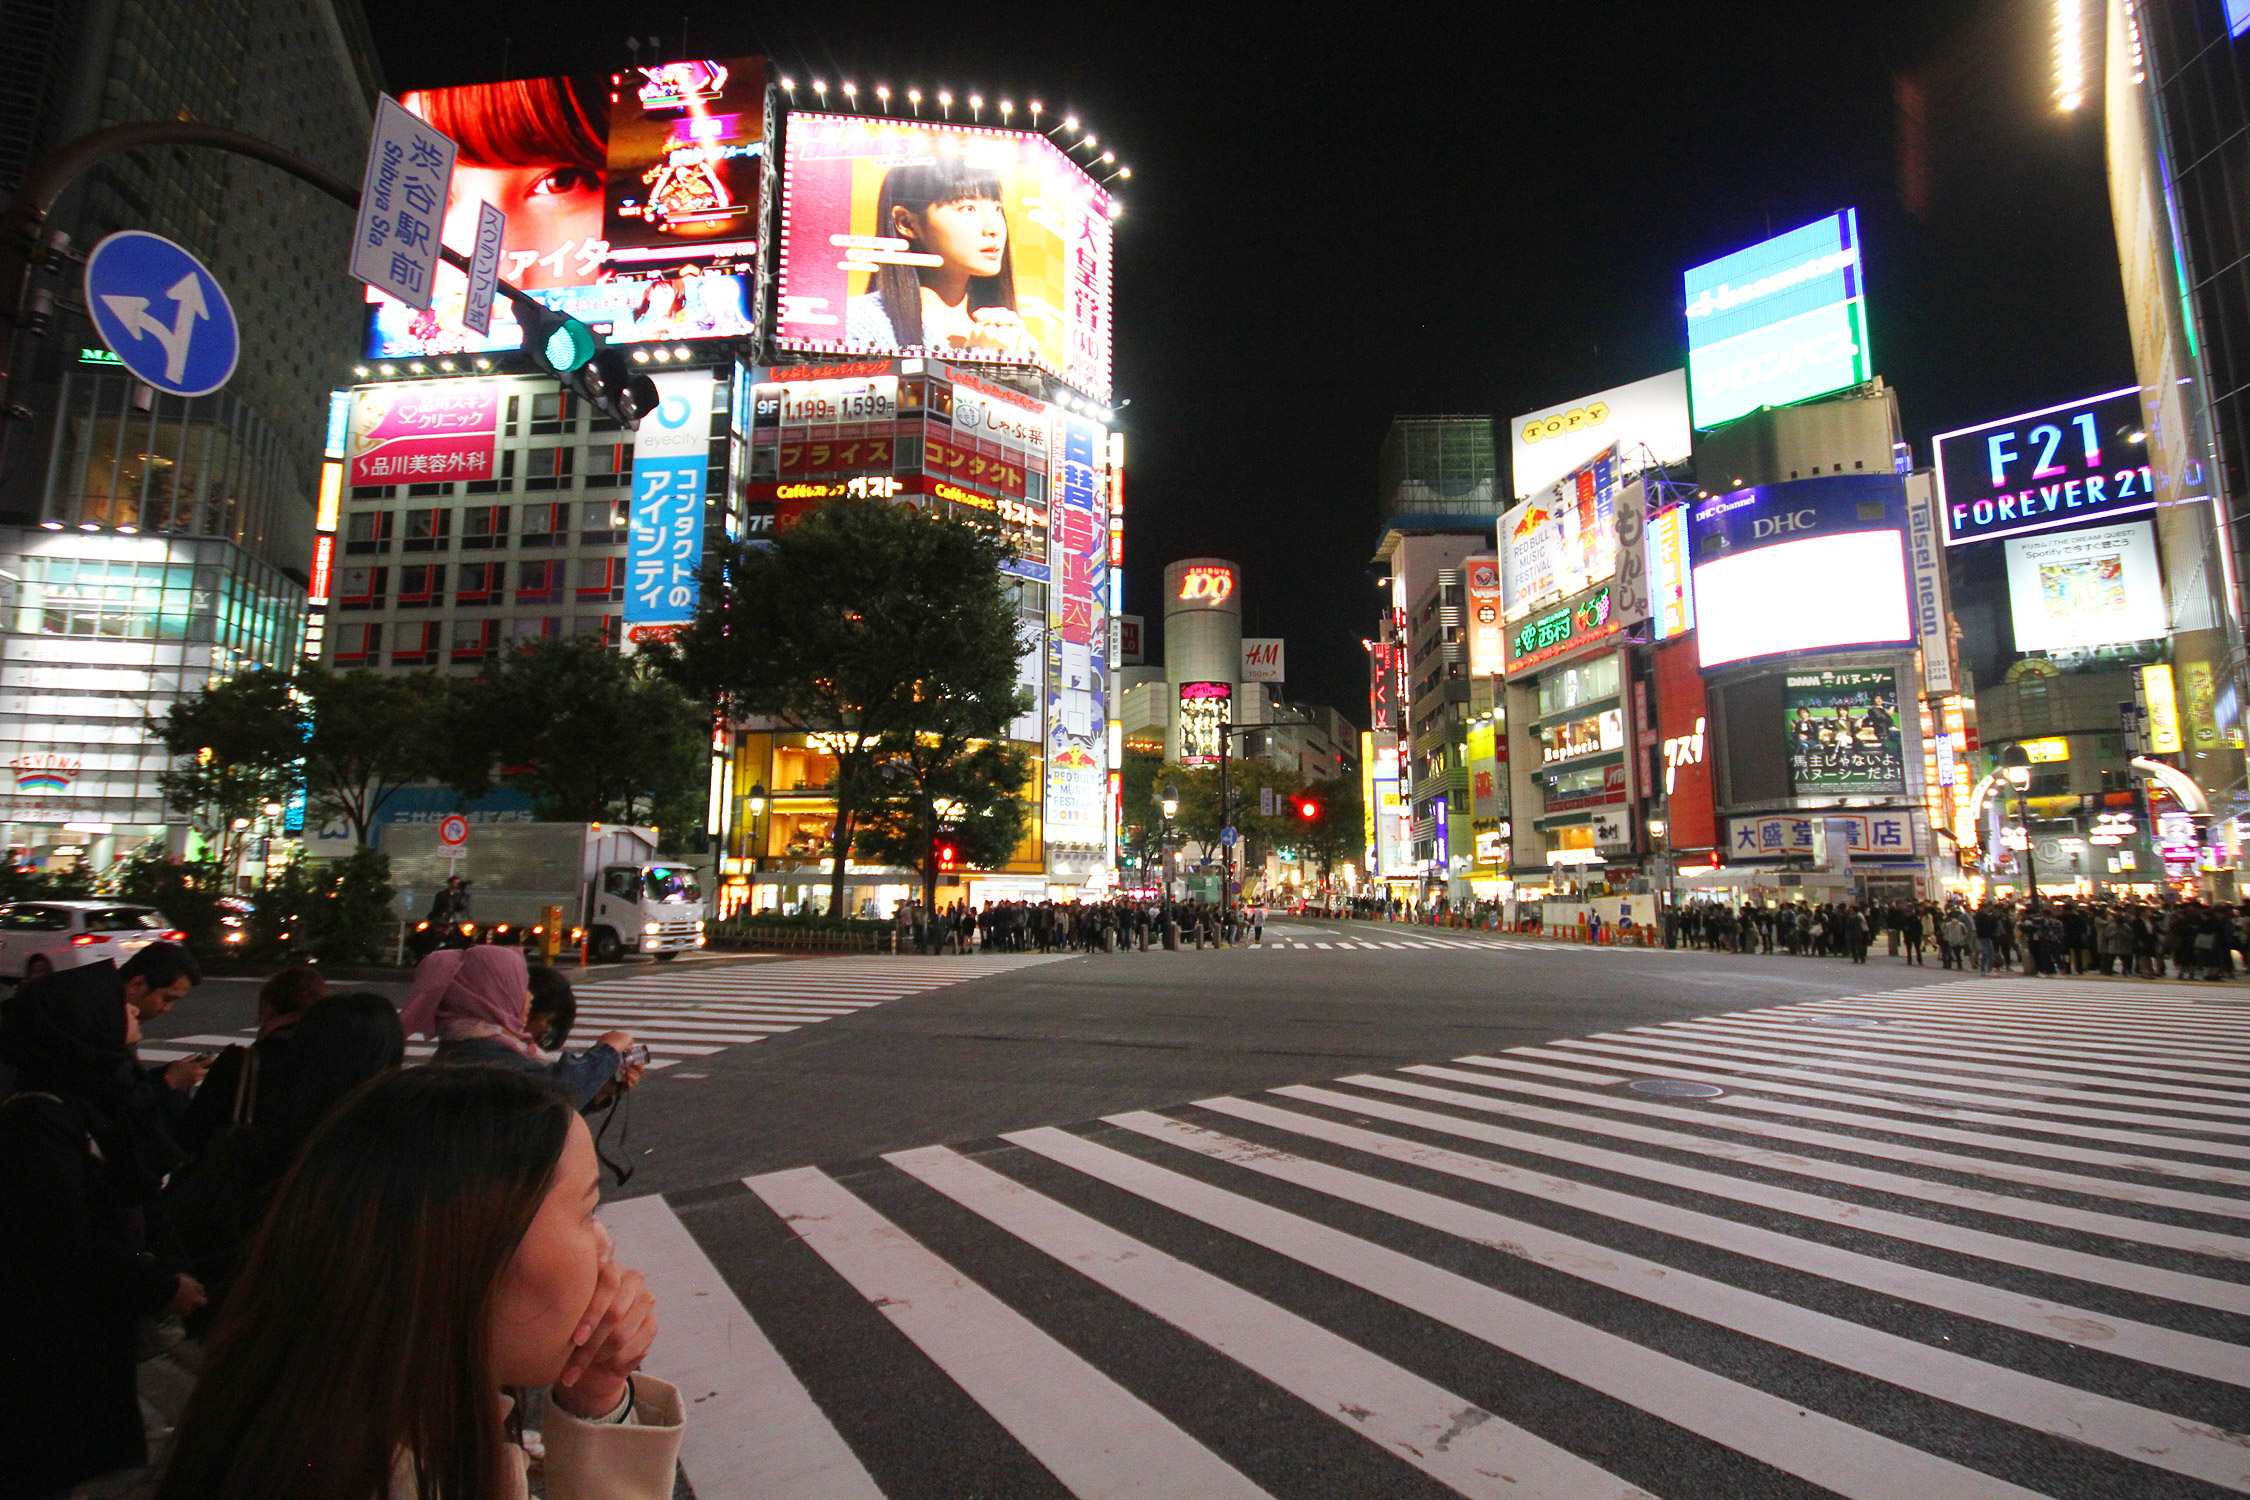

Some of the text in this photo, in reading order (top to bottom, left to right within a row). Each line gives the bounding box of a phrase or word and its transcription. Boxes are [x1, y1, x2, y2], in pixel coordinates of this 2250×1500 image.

[367, 140, 404, 249] Shibuya Sta.
[390, 134, 443, 293] 渋谷駅前
[769, 360, 892, 380] しゃぶしゃぶバイキング
[1698, 328, 1859, 399] サロンパス
[945, 366, 1046, 415] しゃぶしゃぶバイキング
[417, 411, 484, 429] クリニック
[757, 400, 778, 415] 9F
[785, 400, 835, 422] 1,199円
[842, 395, 894, 419] 1,599円
[987, 410, 1044, 446] しゃぶ葉
[1528, 410, 1602, 437] TOPY
[644, 431, 700, 449] eyecity
[1988, 412, 2101, 488] F21
[371, 451, 487, 477] 品川美容外科
[925, 442, 1022, 487] コンタクト
[1696, 495, 1755, 522] DHC Channel
[1953, 465, 2154, 530] FOREVER 21
[750, 514, 775, 531] 7F
[997, 499, 1039, 526] ガスト
[1754, 509, 1817, 539] DHC
[635, 471, 671, 609] アイシティ
[667, 470, 698, 608] コンタクトの
[1514, 532, 1549, 558] RED BULL
[2071, 534, 2101, 543] DREAM
[1519, 546, 1546, 568] MUSIC
[1615, 503, 1647, 616] もんじゃ
[1911, 496, 1937, 636] Taisei neon
[2026, 549, 2062, 559] Spotify
[1190, 567, 1231, 576] SHIBUYA
[1515, 562, 1551, 584] FESTIVAL
[1178, 573, 1234, 605] 109
[1538, 616, 1571, 648] 西村
[1246, 644, 1278, 666] H&M
[1376, 645, 1387, 727] KATE
[1787, 673, 1892, 688] DMM バヌーシー
[1543, 737, 1599, 762] Euphoria
[1793, 754, 1901, 768] 馬主じゃないよ、
[1054, 771, 1072, 782] RED
[1607, 767, 1625, 786] JTB
[1060, 785, 1091, 796] MUSIC
